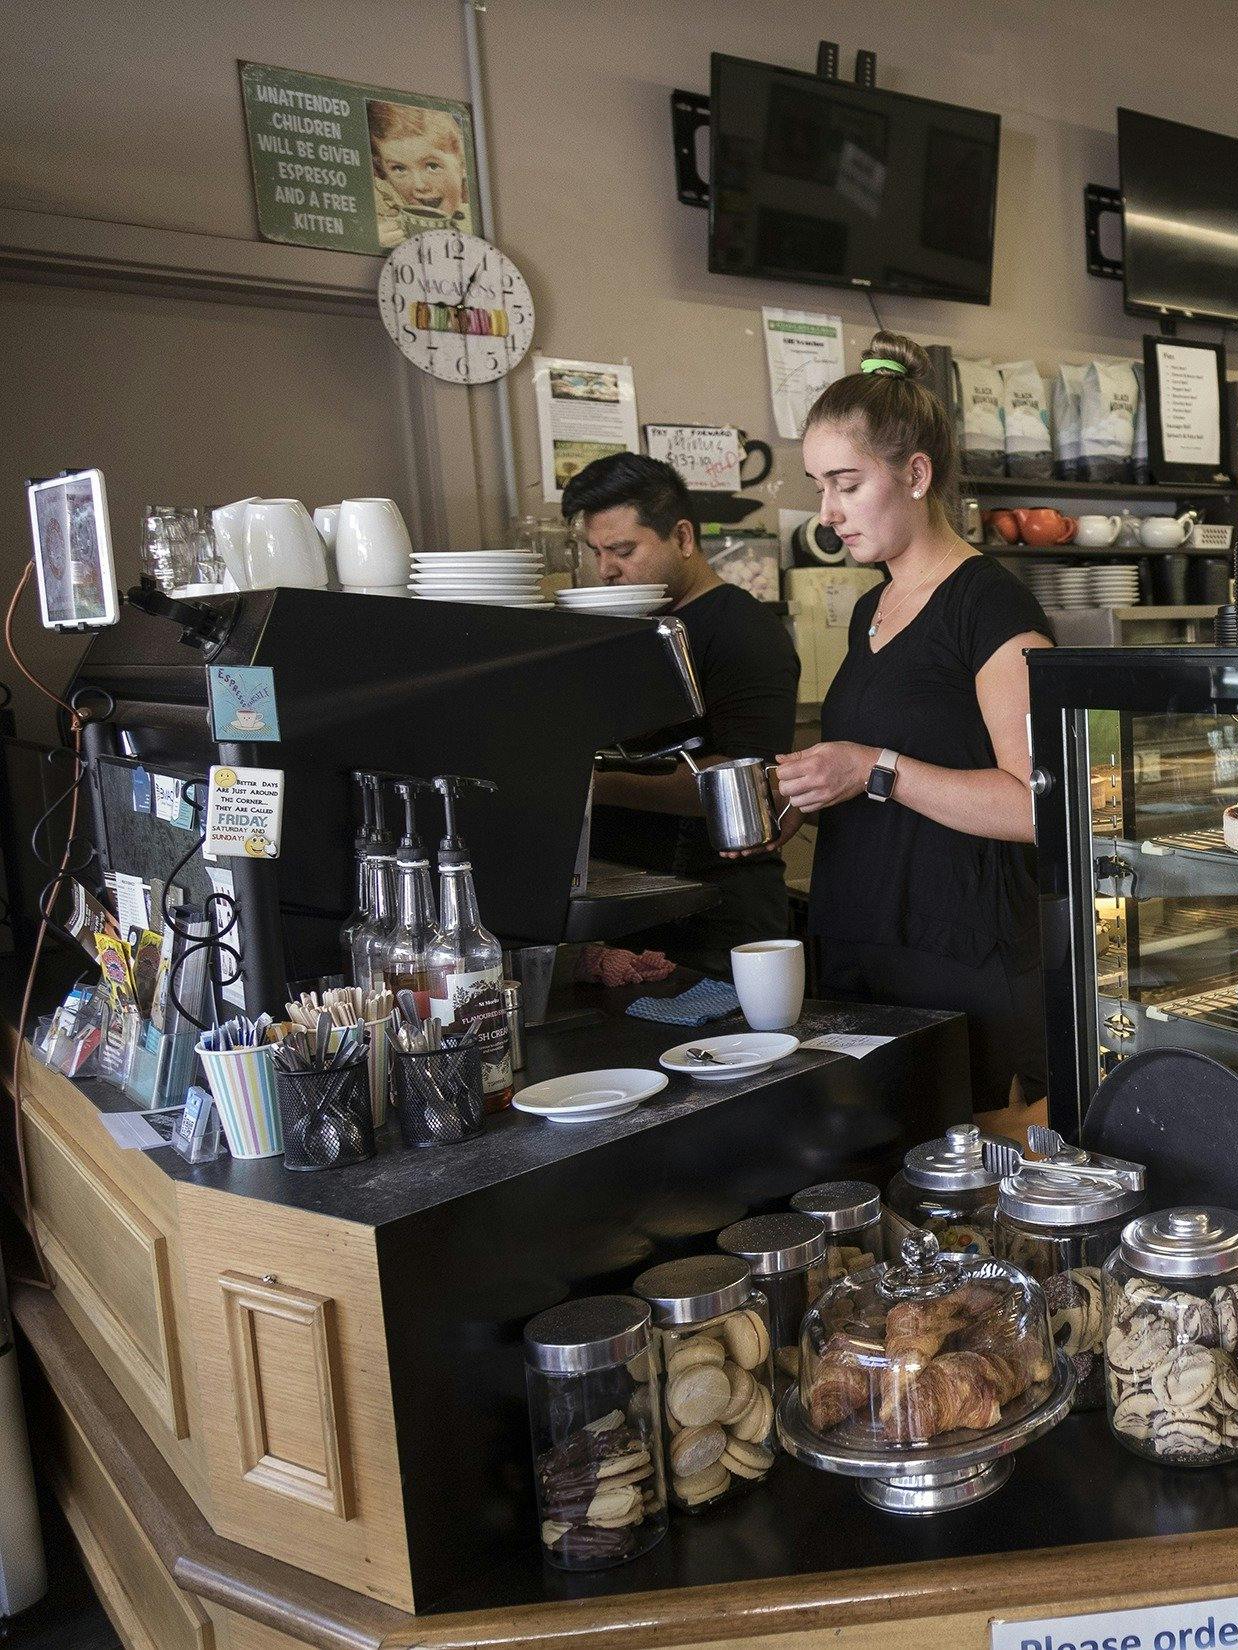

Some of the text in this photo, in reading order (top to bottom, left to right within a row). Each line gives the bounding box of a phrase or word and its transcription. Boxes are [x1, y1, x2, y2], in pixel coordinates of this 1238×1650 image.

[257, 85, 350, 117] UNATTENDED
[272, 113, 342, 140] CHILDREN
[257, 134, 360, 167] WILL BE GIVEN
[278, 162, 348, 188] ESPRESSO
[275, 186, 357, 213] AND A FREE
[294, 213, 344, 235] KITTEN
[445, 240, 465, 260] 12
[395, 264, 415, 285] 10
